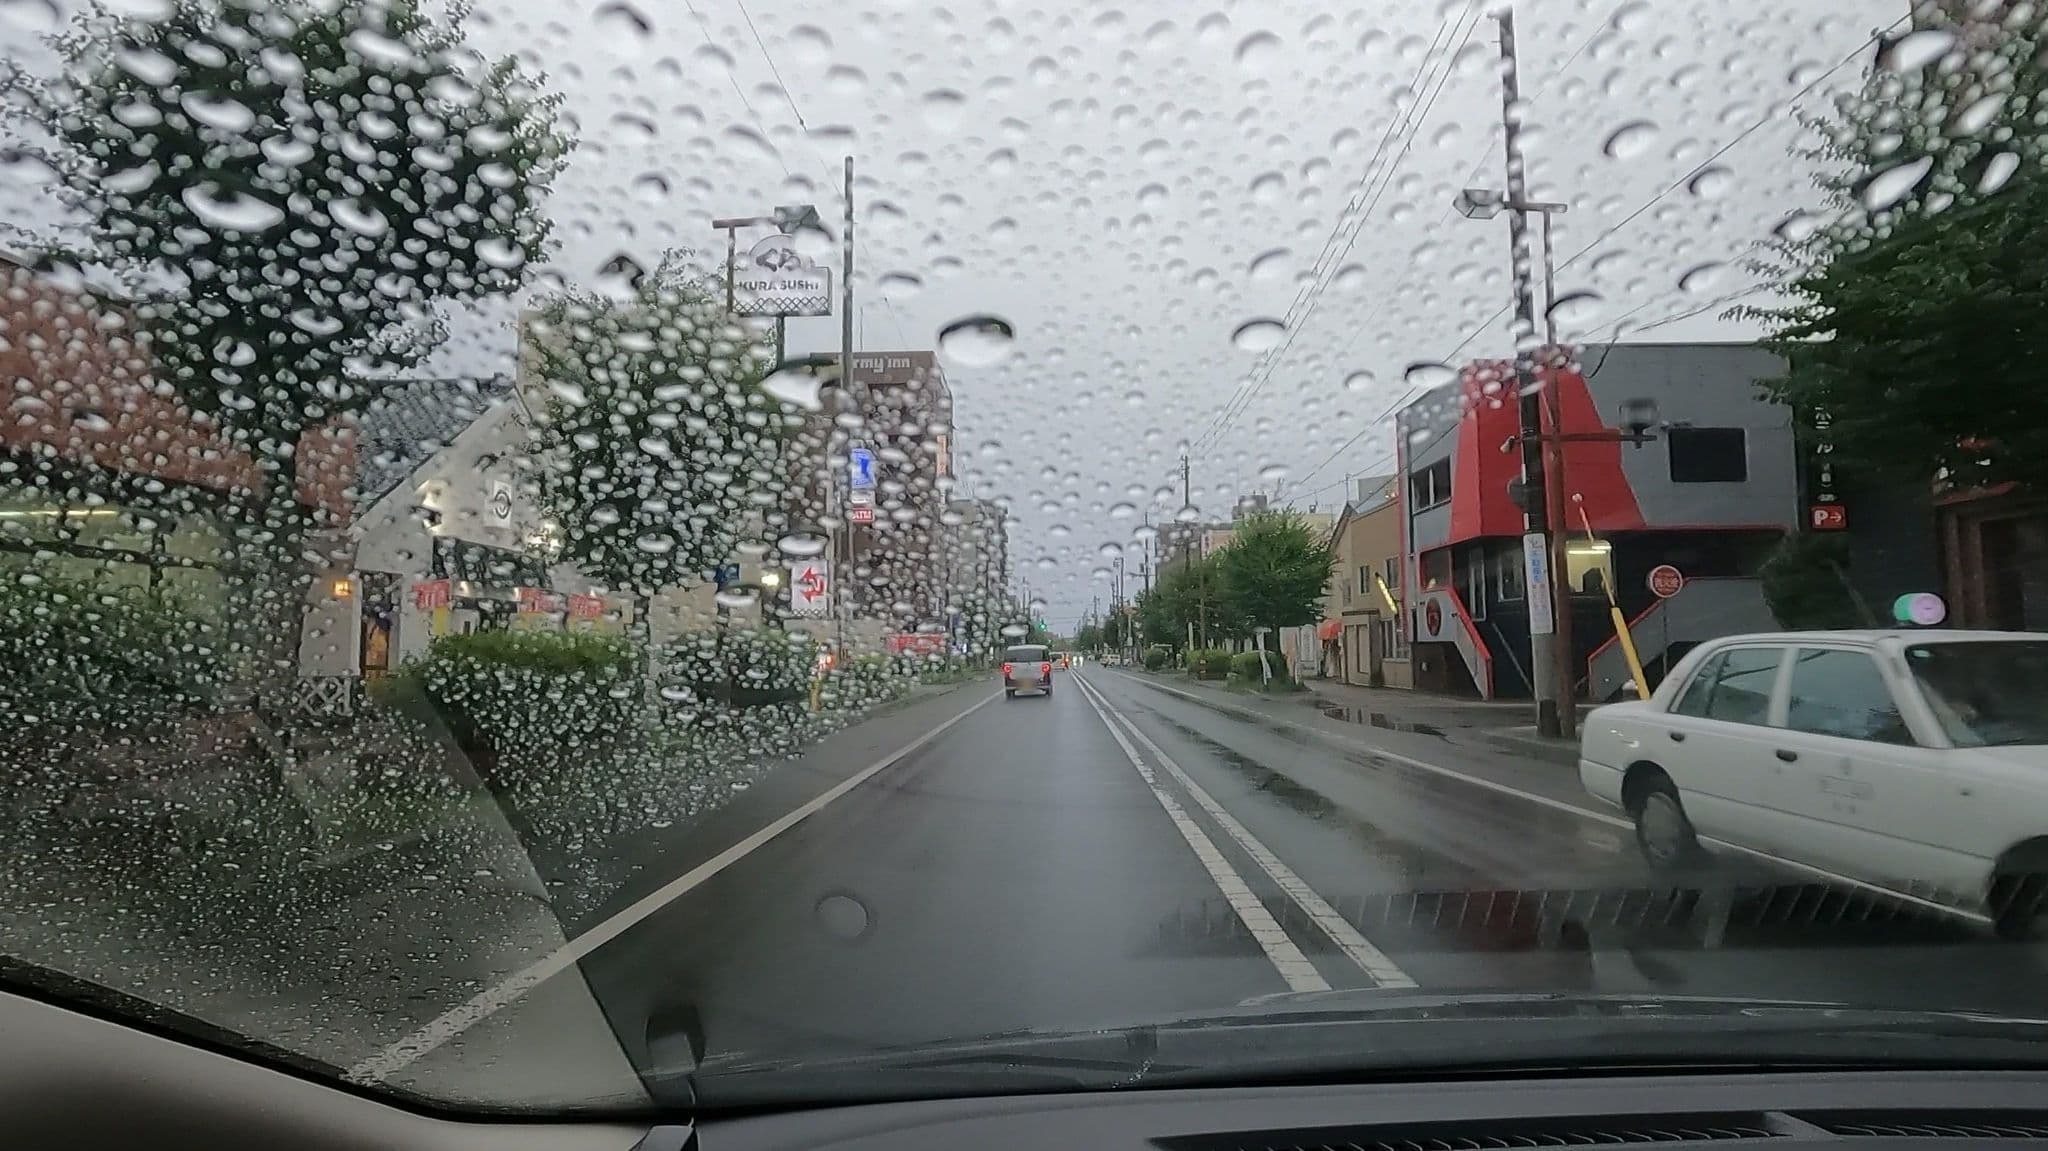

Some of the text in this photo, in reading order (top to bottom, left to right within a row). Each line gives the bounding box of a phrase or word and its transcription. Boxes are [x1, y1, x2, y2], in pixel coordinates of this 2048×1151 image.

[739, 280, 819, 291] KURA SUSHI
[1814, 509, 1829, 525] P
